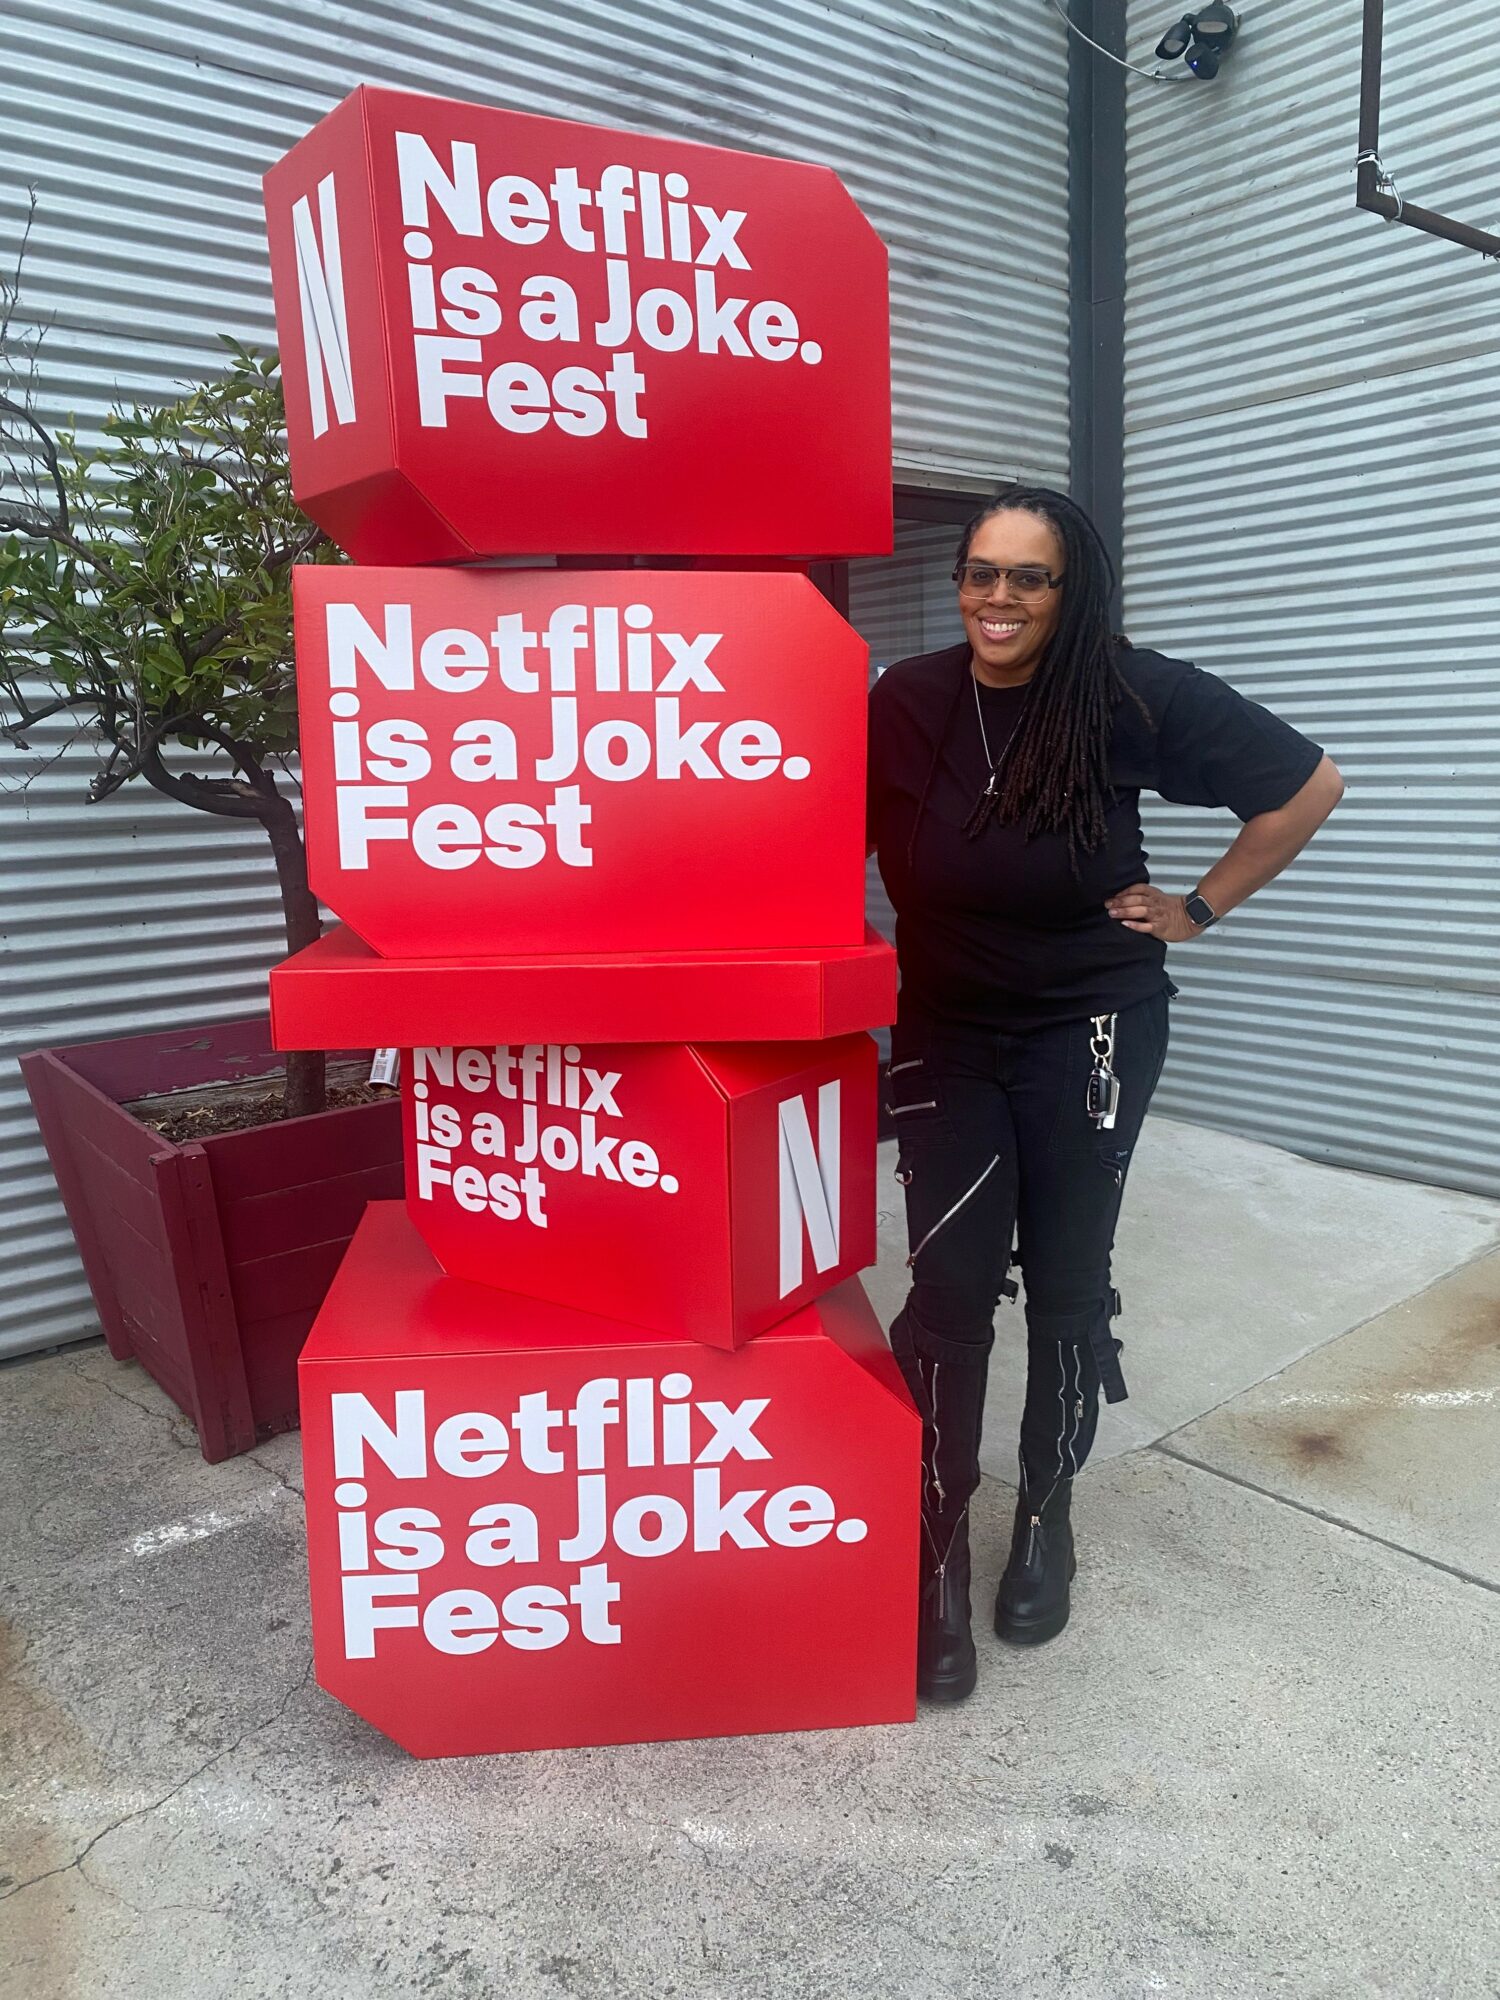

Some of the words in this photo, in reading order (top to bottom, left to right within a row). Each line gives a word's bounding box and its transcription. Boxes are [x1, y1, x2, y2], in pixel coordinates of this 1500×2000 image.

[395, 130, 753, 271] Netflix
[292, 172, 356, 440] N
[403, 231, 502, 336] is
[519, 275, 580, 343] a
[594, 258, 823, 365] Joke.
[414, 334, 648, 439] Fest
[326, 603, 726, 694] Netflix
[329, 692, 432, 783] is
[450, 719, 519, 783] a
[536, 696, 811, 783] Joke.
[336, 785, 593, 870] Fest
[413, 1044, 624, 1118] Netflix
[414, 1082, 462, 1148] is
[470, 1112, 506, 1158] a
[514, 1104, 679, 1194] Joke.
[417, 1143, 548, 1229] Fest
[779, 1079, 841, 1300] N
[331, 1372, 773, 1480] Netflix
[335, 1482, 445, 1572] is
[465, 1502, 540, 1567] a
[558, 1467, 868, 1563] Joke.
[341, 1563, 622, 1660] Fest
